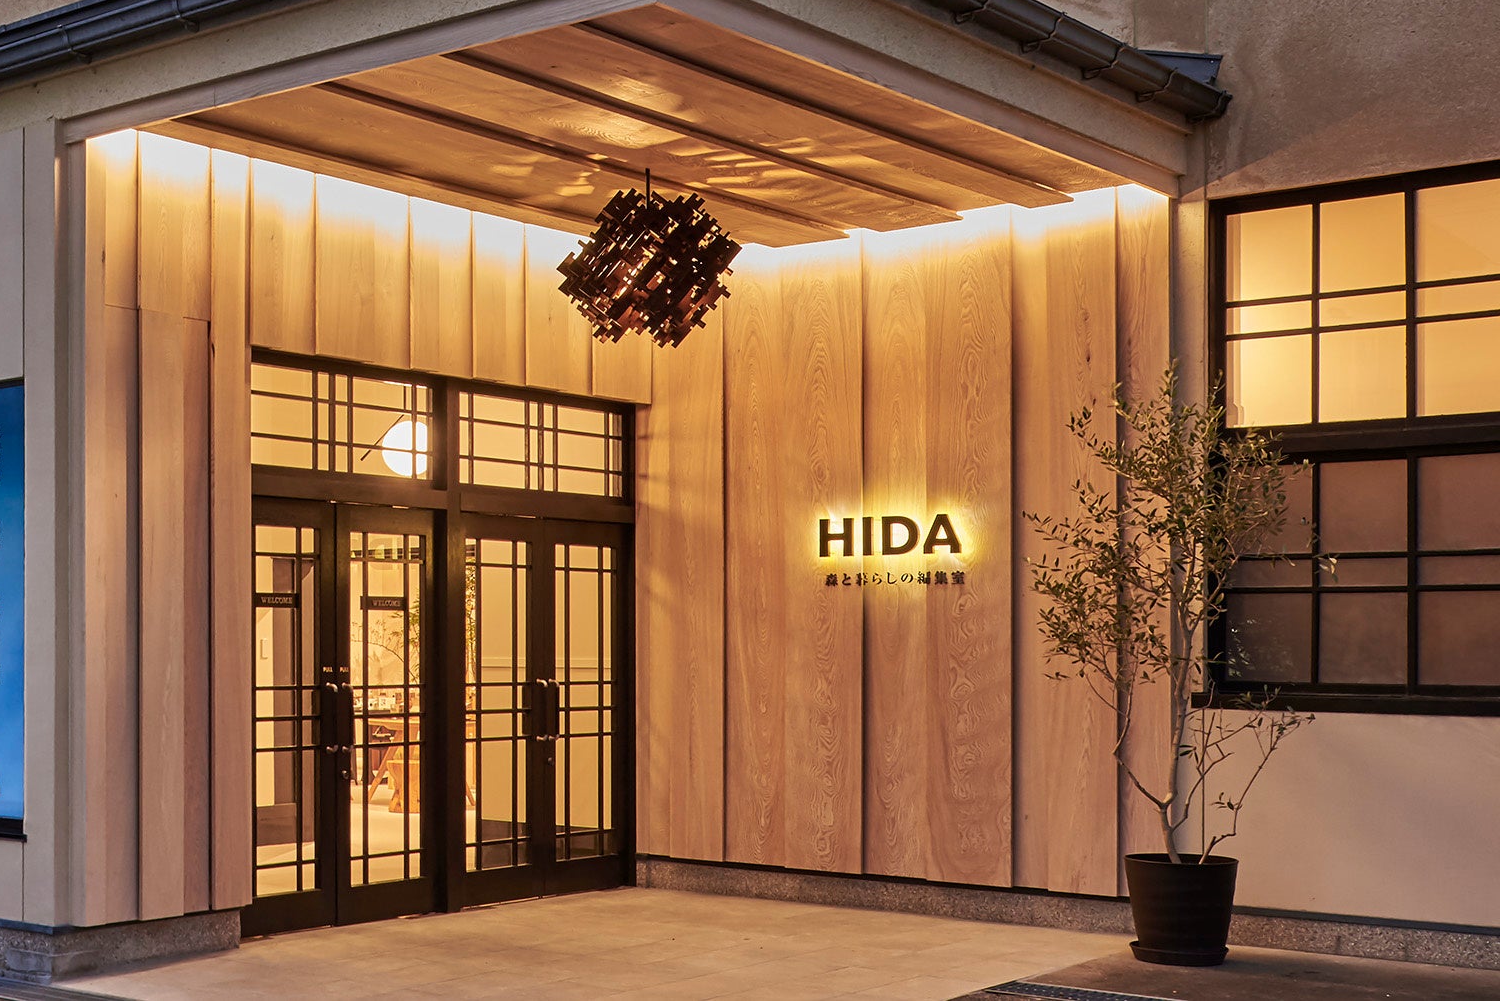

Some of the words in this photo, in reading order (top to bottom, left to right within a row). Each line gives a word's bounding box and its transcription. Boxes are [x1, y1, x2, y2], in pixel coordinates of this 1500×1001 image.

[819, 514, 962, 557] HIDA
[825, 571, 965, 587] 森と暮らしの編集室
[260, 596, 293, 604] WELCOME
